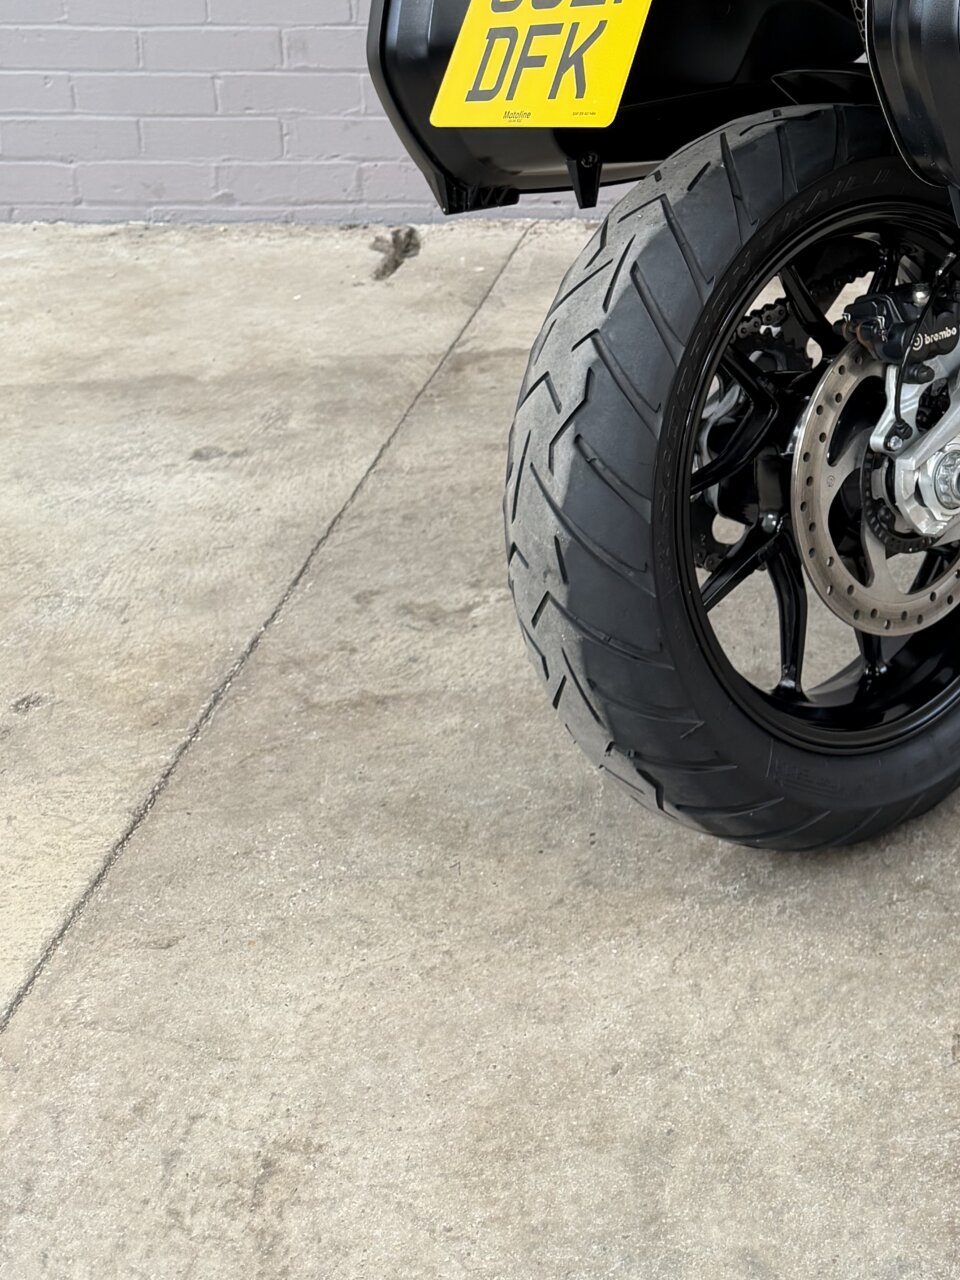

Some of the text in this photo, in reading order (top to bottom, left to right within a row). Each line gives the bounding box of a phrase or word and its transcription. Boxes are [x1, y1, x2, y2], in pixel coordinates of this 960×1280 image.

[465, 20, 608, 102] DFK
[502, 110, 532, 119] Motoline
[924, 326, 957, 345] brembo
